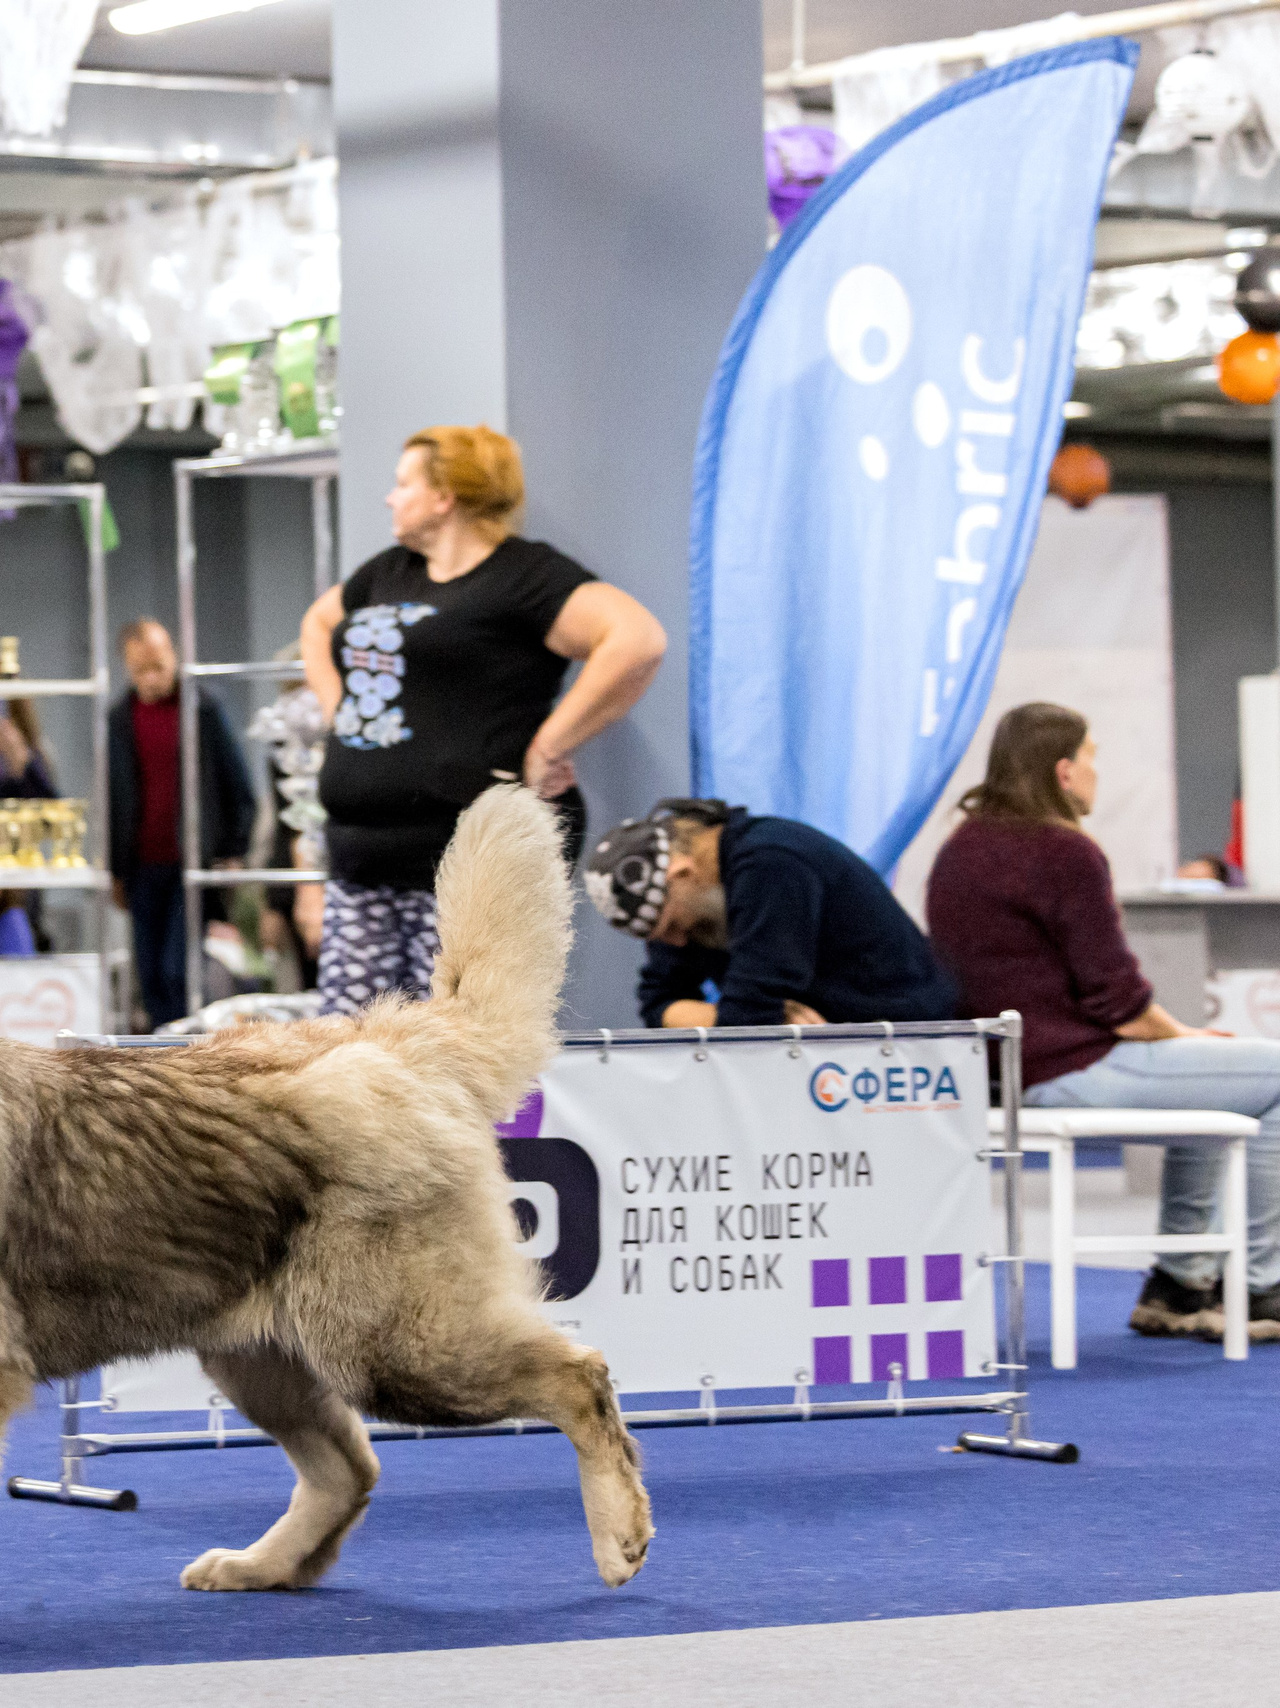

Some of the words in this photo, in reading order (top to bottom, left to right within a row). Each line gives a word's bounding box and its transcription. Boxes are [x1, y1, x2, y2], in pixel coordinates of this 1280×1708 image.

[809, 1061, 960, 1112] СФЕРА
[622, 1155, 732, 1194] СУХИЕ
[763, 1151, 873, 1190] КОРМА
[622, 1207, 687, 1251] ДЛЯ
[717, 1202, 829, 1241] КОШЕК
[624, 1257, 642, 1295] И
[671, 1255, 783, 1292] СОБАК
